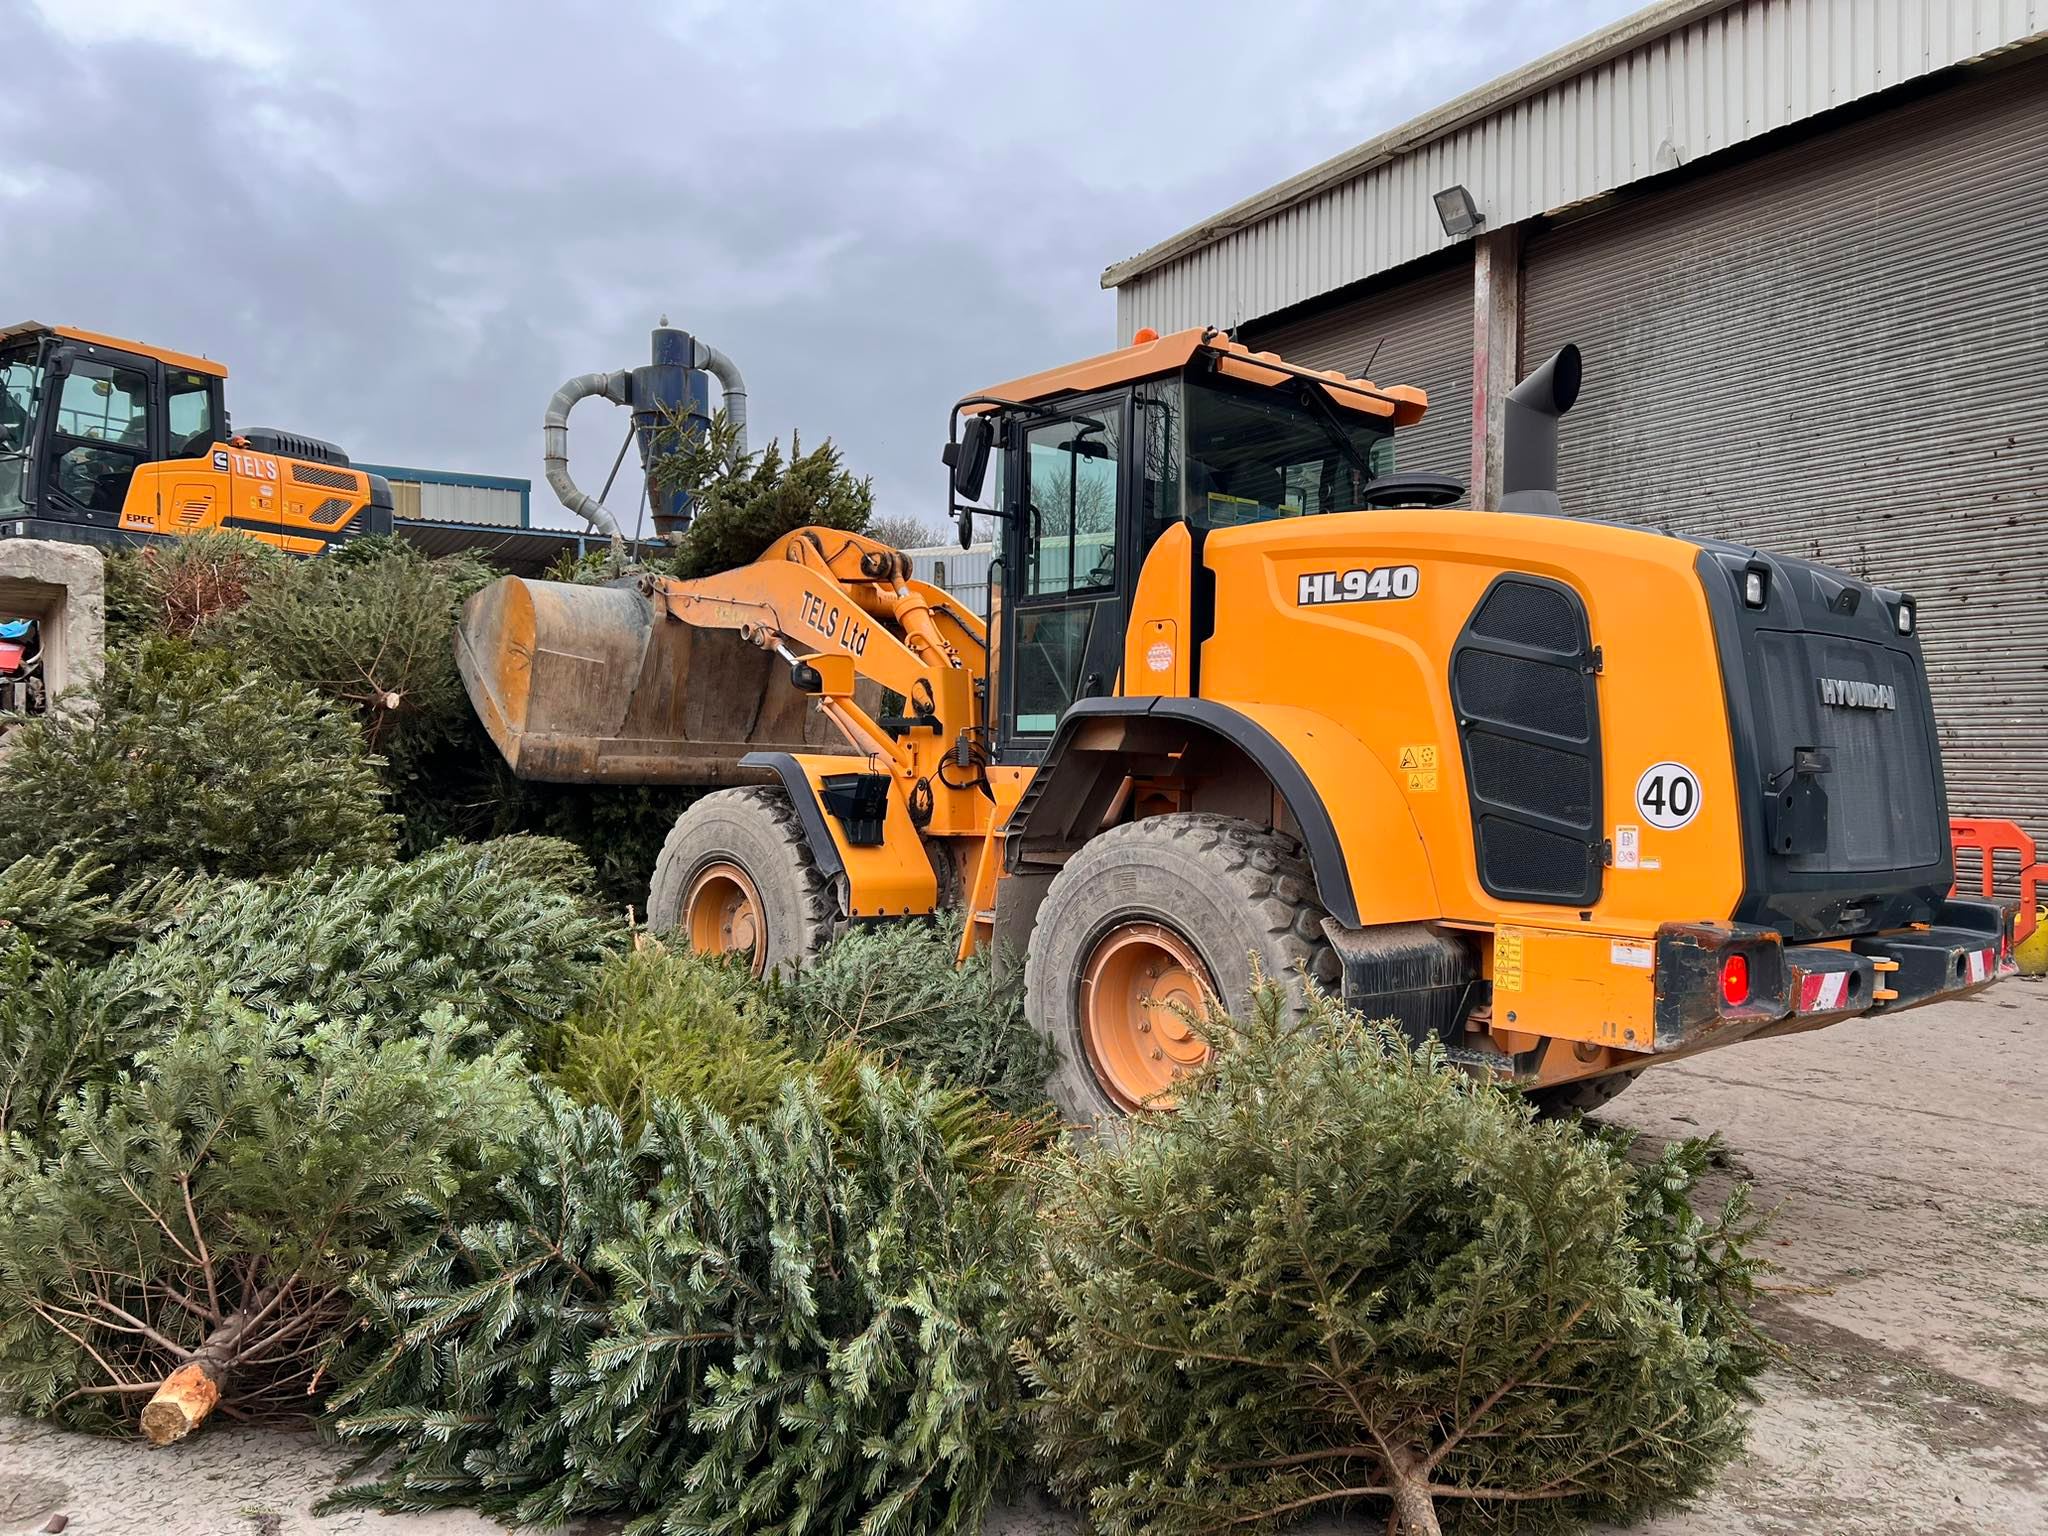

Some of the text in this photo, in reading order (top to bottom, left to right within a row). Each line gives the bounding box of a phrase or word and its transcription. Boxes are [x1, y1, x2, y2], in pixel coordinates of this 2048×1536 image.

[231, 454, 277, 480] TEL'S
[126, 513, 155, 525] EPFC
[1299, 566, 1418, 604] HL940
[800, 590, 839, 638] TELS
[840, 616, 869, 656] Ltd
[1820, 678, 1896, 710] HYUNDAI
[1642, 775, 1693, 817] 40
